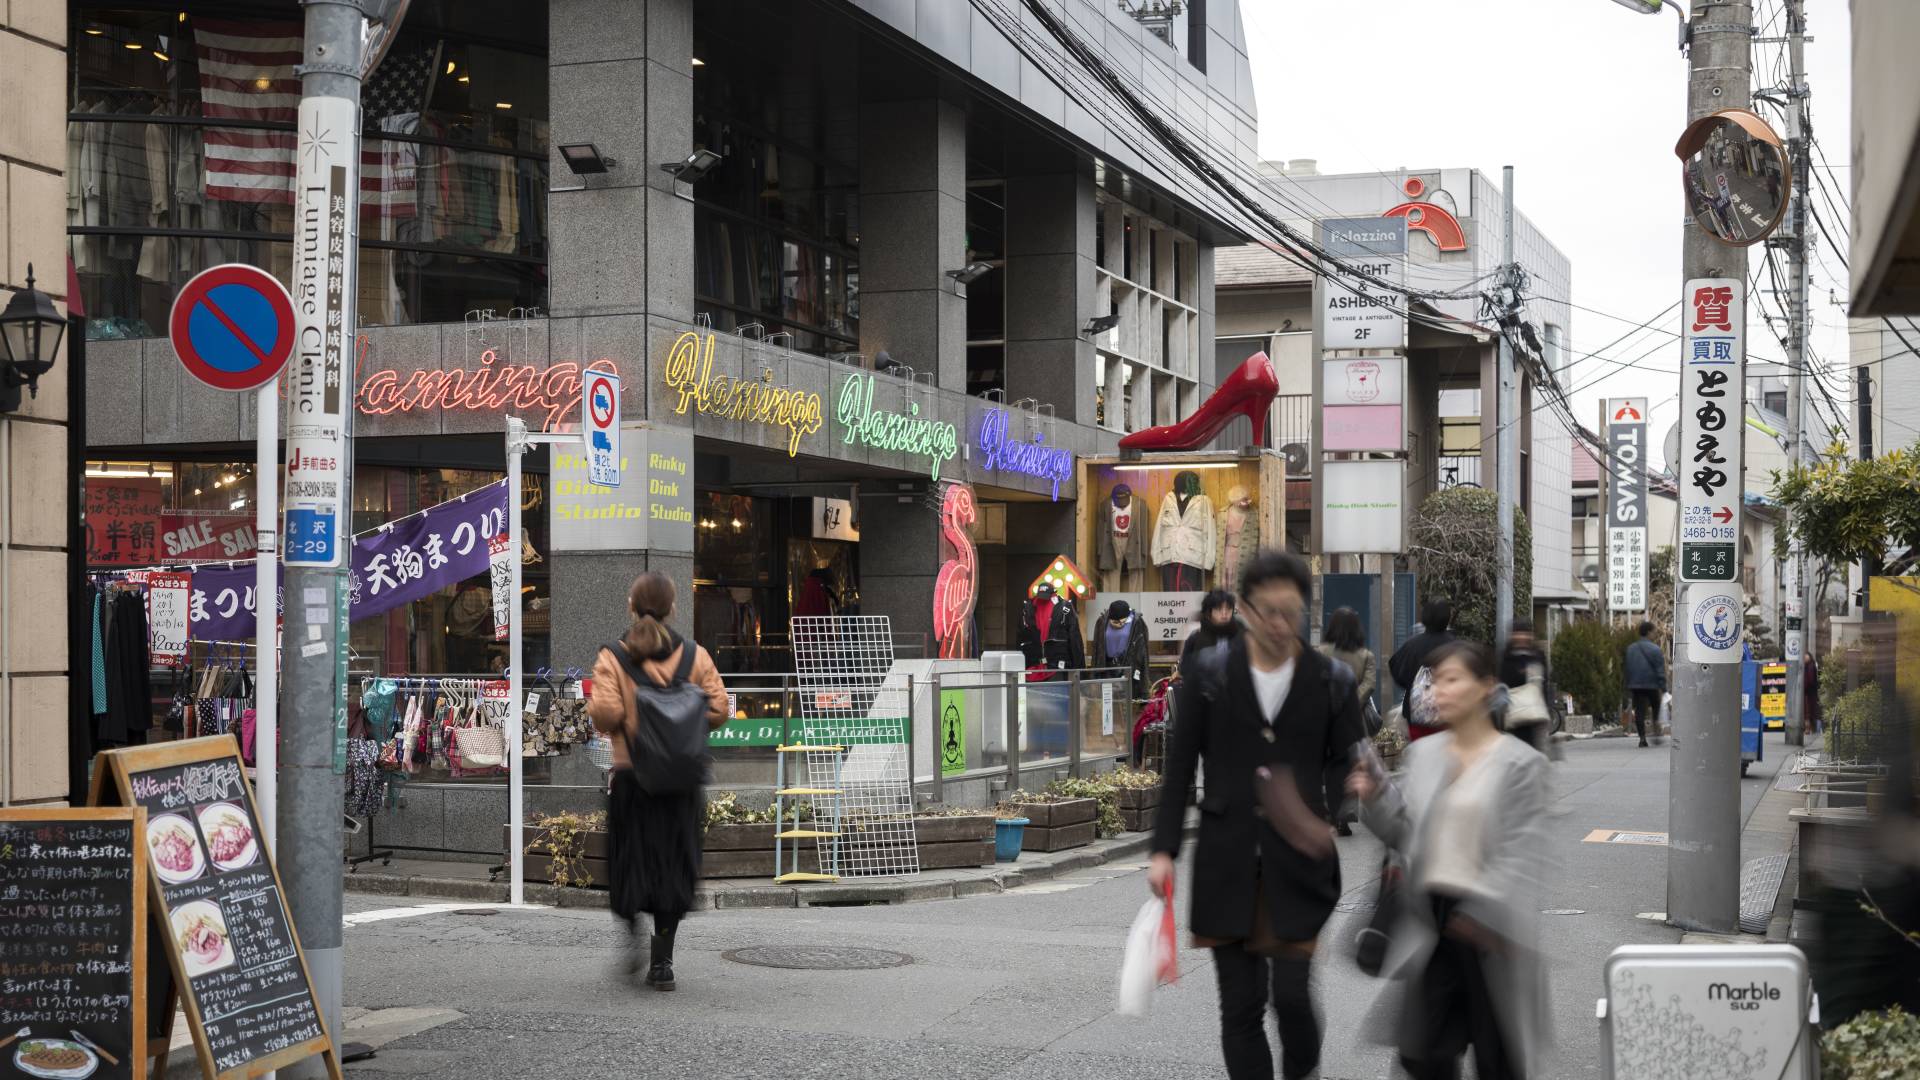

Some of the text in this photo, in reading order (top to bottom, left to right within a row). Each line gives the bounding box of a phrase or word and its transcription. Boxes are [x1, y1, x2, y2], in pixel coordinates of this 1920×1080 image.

[300, 185, 326, 315] Lumiage
[325, 194, 345, 388] 美容皮膚科・形成外科
[1358, 280, 1367, 291] &
[1692, 286, 1733, 332] 質
[1354, 328, 1371, 340] 2F
[1693, 341, 1731, 360] 買取
[300, 326, 322, 414] Clinic
[665, 331, 822, 458] Flamingo
[838, 372, 957, 482] Flamingo
[1693, 370, 1729, 497] ともえや
[302, 456, 337, 470] 手前曲る
[980, 407, 1073, 502] Flamingo
[650, 453, 686, 476] Rinky
[1616, 427, 1639, 522] TOMAS
[650, 478, 679, 497] Dink
[556, 502, 641, 520] Studio
[650, 503, 692, 522] Studio
[1685, 506, 1711, 515] この先
[106, 519, 157, 551] 半額
[163, 519, 217, 556] SALE
[219, 525, 258, 557] SAL
[288, 540, 327, 553] 2-29
[364, 507, 503, 595] 天狗まつり
[1691, 551, 1726, 562] 北沢
[1691, 564, 1725, 575] 2-36
[1154, 616, 1189, 624] ASHBURY
[1163, 628, 1178, 638] 2F
[709, 726, 751, 741] nky
